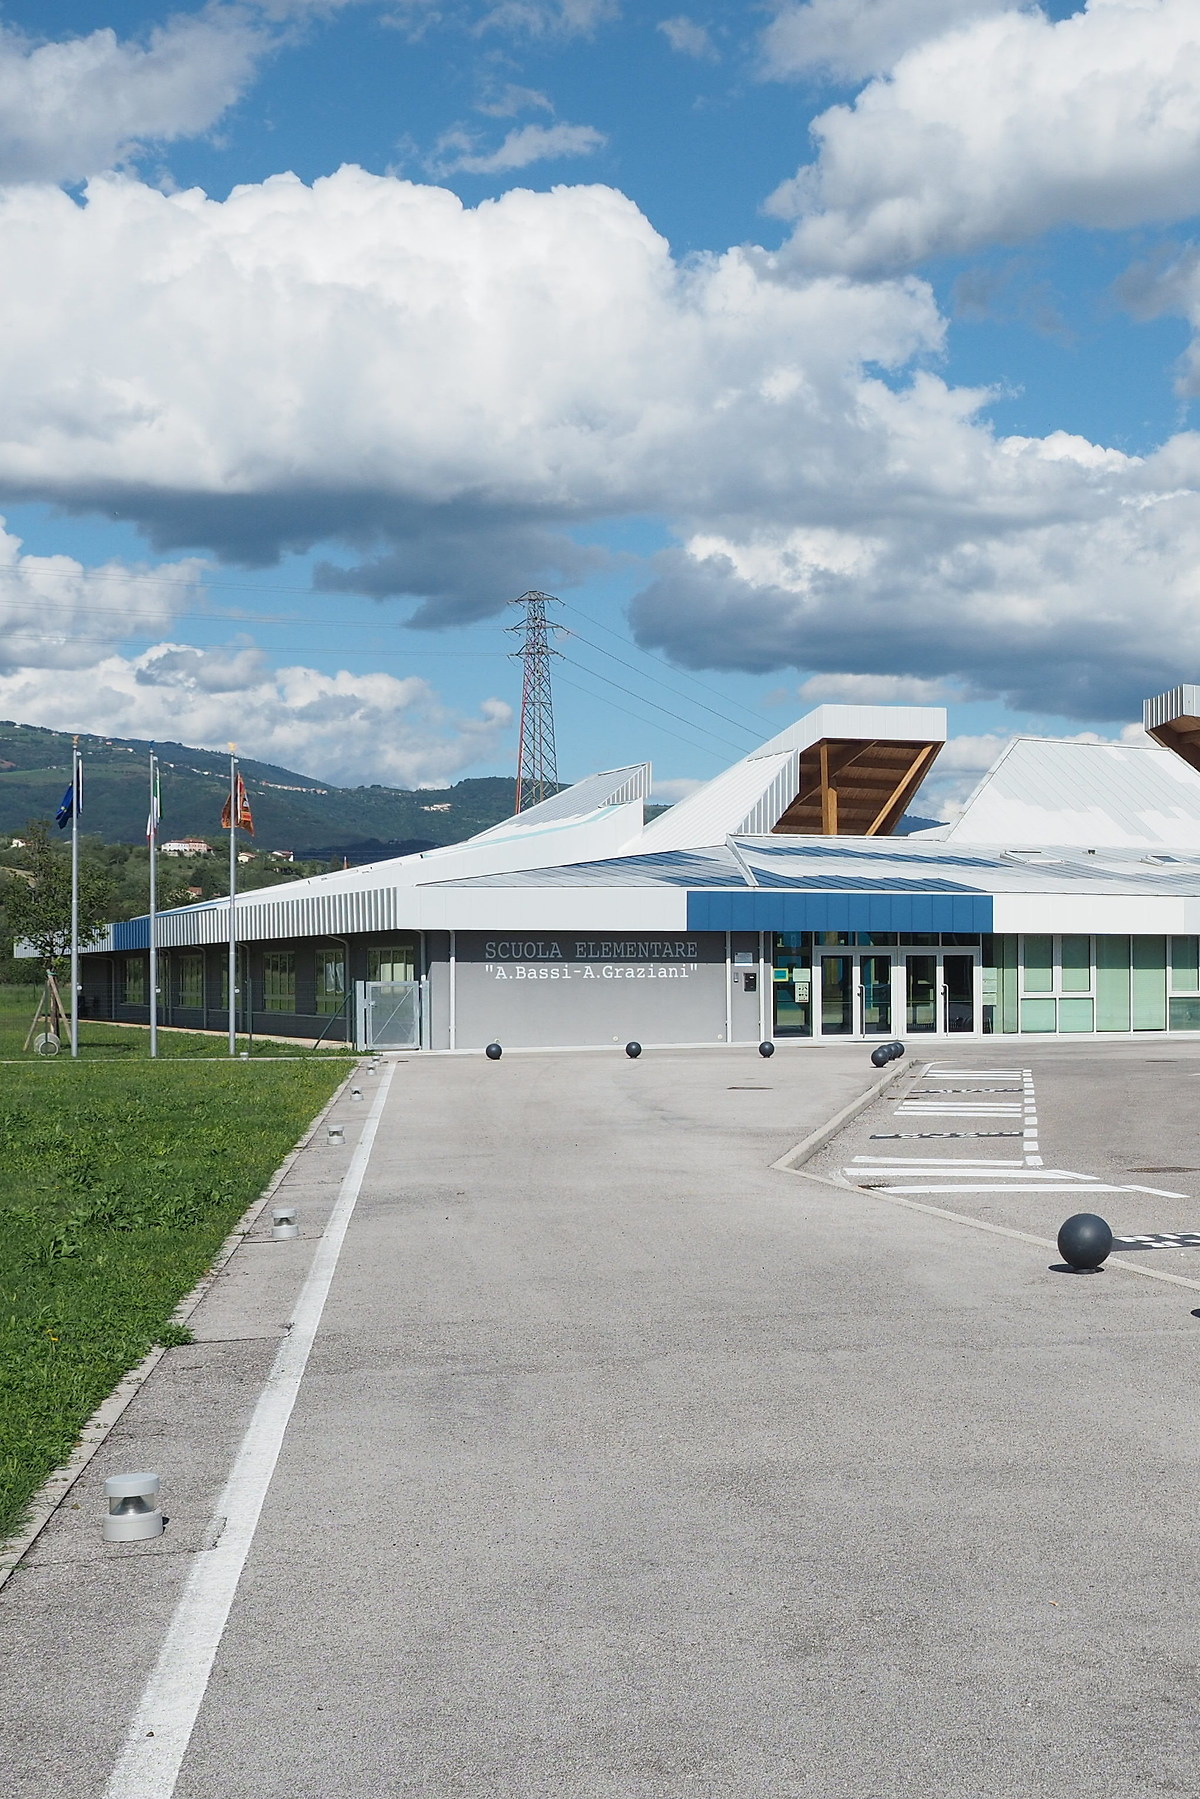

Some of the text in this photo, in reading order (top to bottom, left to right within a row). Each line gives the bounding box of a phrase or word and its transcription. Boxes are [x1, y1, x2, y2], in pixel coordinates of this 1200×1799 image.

[485, 941, 698, 959] SCUOLA ELEMENTARE
[485, 964, 698, 980] "A.Bassi-A.Graziani"
